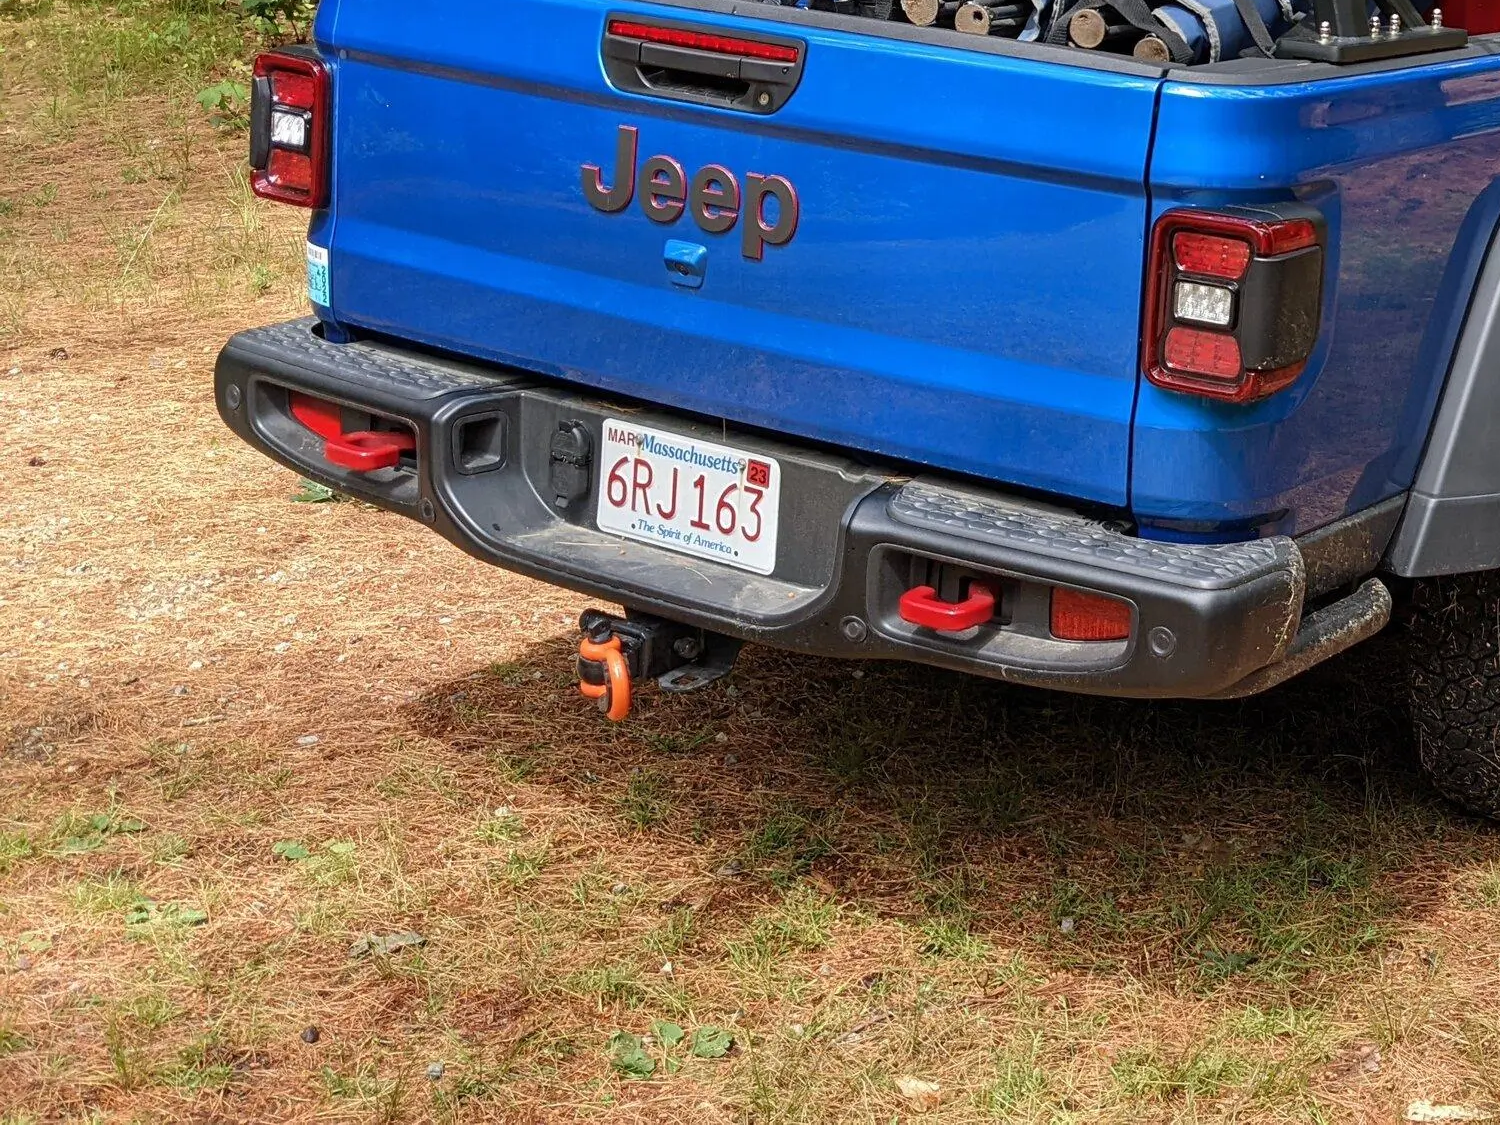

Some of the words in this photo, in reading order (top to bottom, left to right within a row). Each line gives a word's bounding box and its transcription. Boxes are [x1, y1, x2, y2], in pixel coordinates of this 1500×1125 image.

[580, 124, 798, 261] Jeep
[608, 427, 635, 447] MAR
[641, 433, 738, 475] Massachusetts
[749, 466, 767, 485] 23
[637, 518, 655, 532] The
[657, 523, 681, 539] Spirit
[683, 532, 692, 545] of
[693, 534, 732, 554] America
